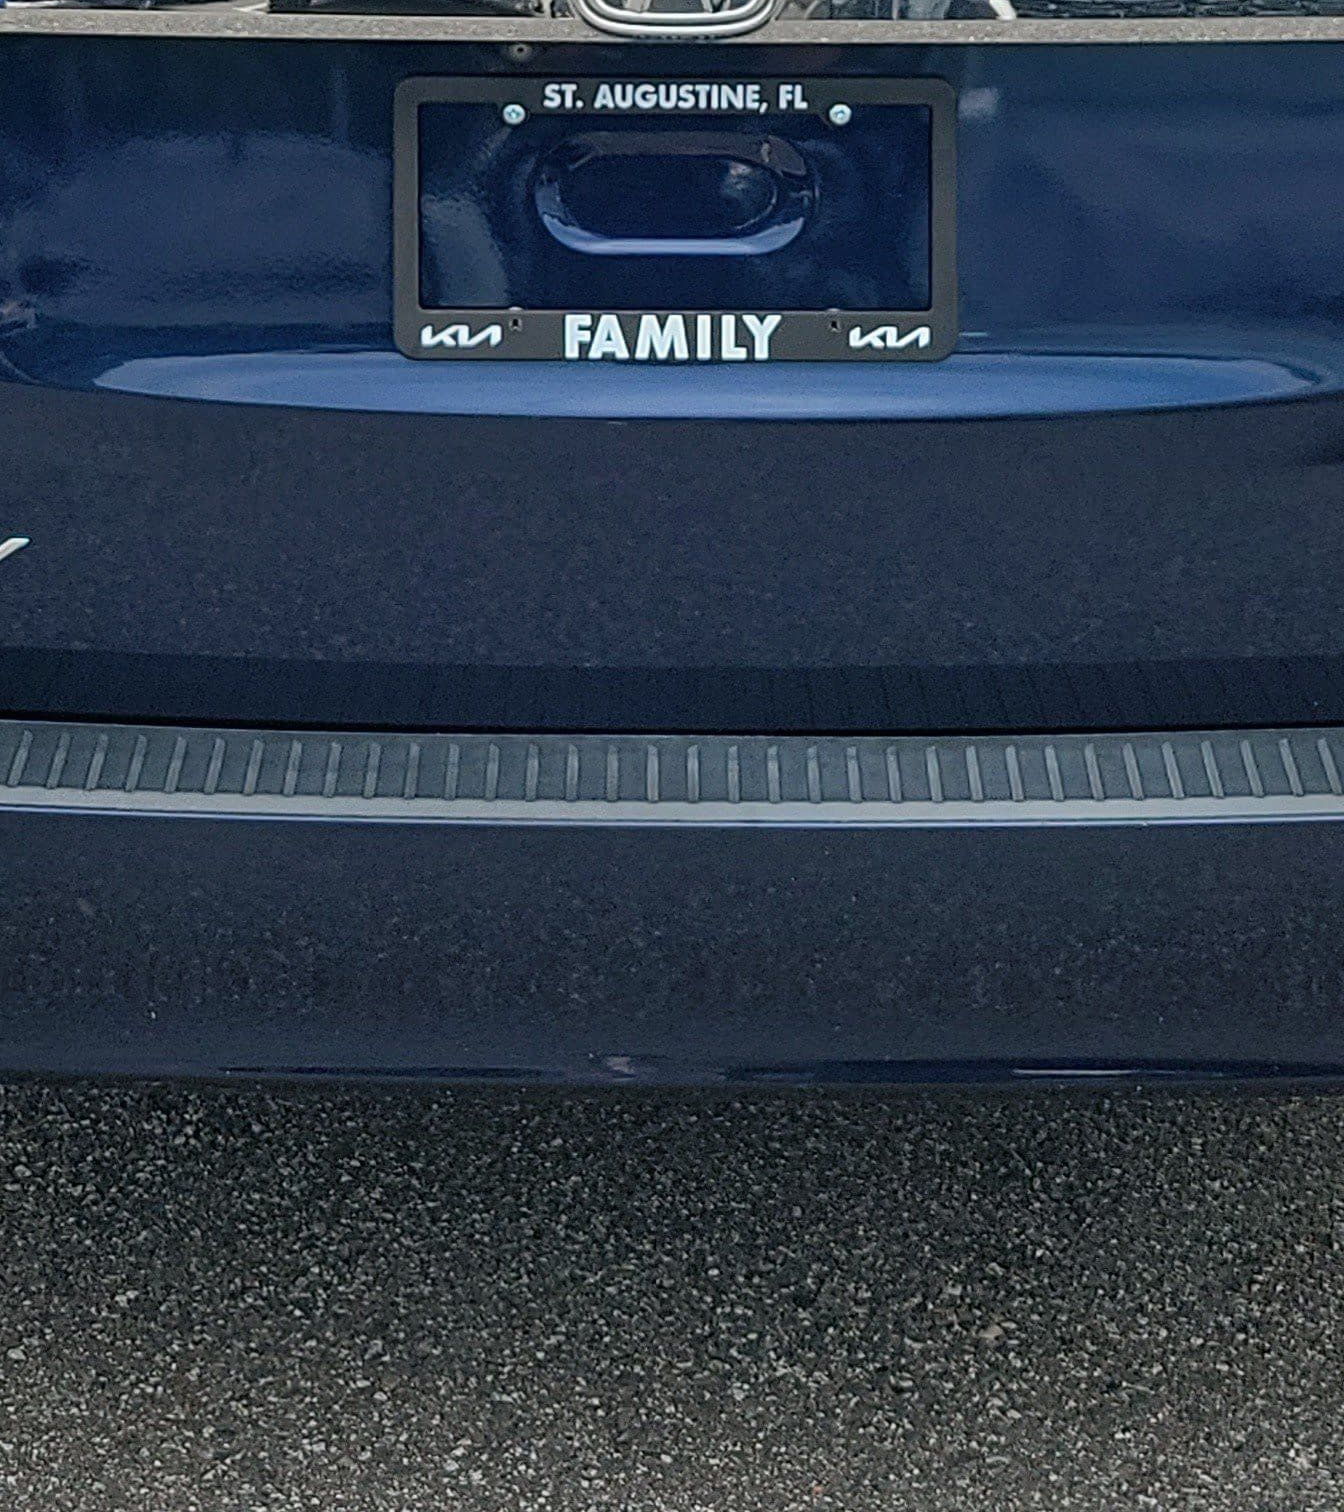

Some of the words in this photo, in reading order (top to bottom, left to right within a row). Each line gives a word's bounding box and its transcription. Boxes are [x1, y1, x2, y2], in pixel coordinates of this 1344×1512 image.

[543, 84, 584, 109] ST.
[593, 85, 767, 113] AUGUSTINE,
[779, 87, 808, 110] FL
[564, 314, 782, 361] FAMILY
